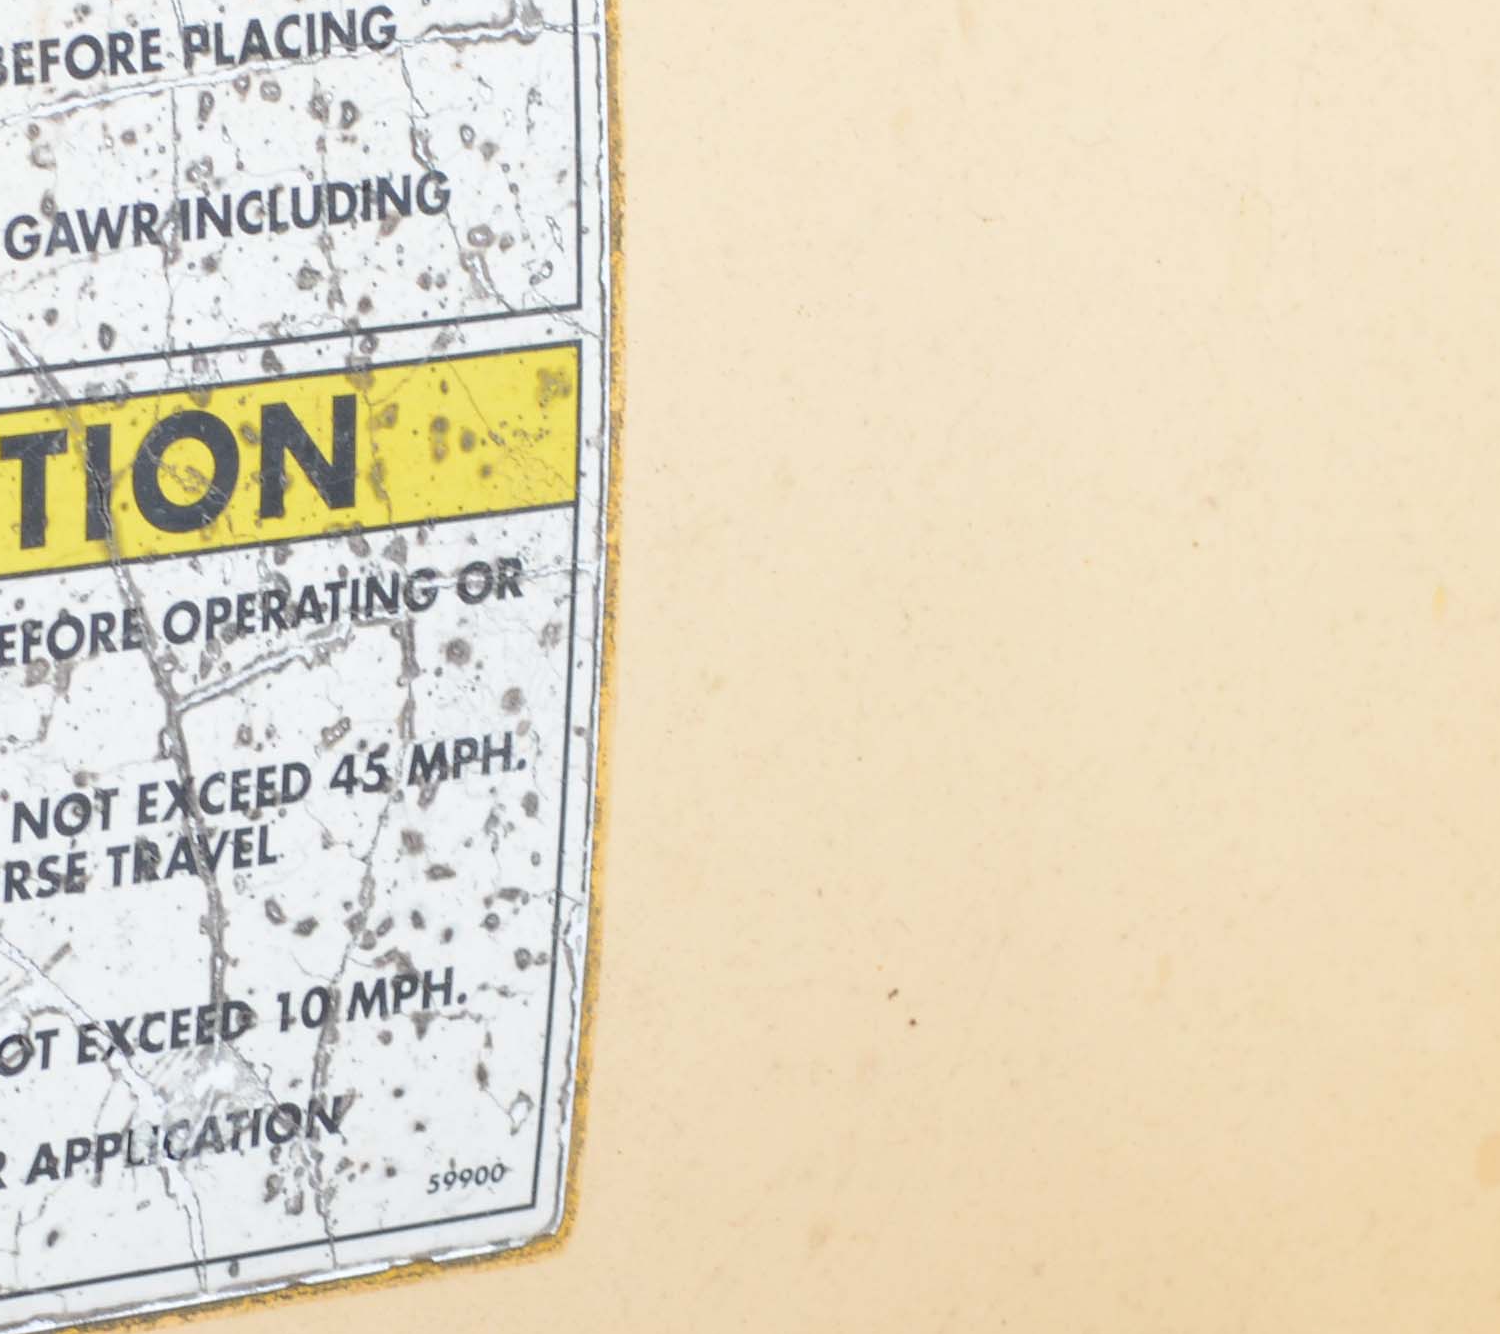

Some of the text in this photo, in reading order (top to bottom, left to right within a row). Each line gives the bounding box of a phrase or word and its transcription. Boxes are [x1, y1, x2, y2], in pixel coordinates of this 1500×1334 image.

[182, 5, 396, 68] PLACING
[4, 202, 161, 260] GAWR
[181, 170, 450, 242] INCLUDING
[163, 571, 439, 645] OPERATING
[456, 557, 524, 604] OR
[13, 789, 119, 843] NOT
[138, 761, 311, 826] EXCEED
[330, 751, 389, 796] 45
[408, 731, 527, 785] MPH.
[107, 826, 278, 887] TRAVEL
[77, 998, 252, 1065] EXCEED
[277, 986, 330, 1032] 10
[346, 967, 467, 1026] MPH.
[426, 1163, 507, 1196] 59900
